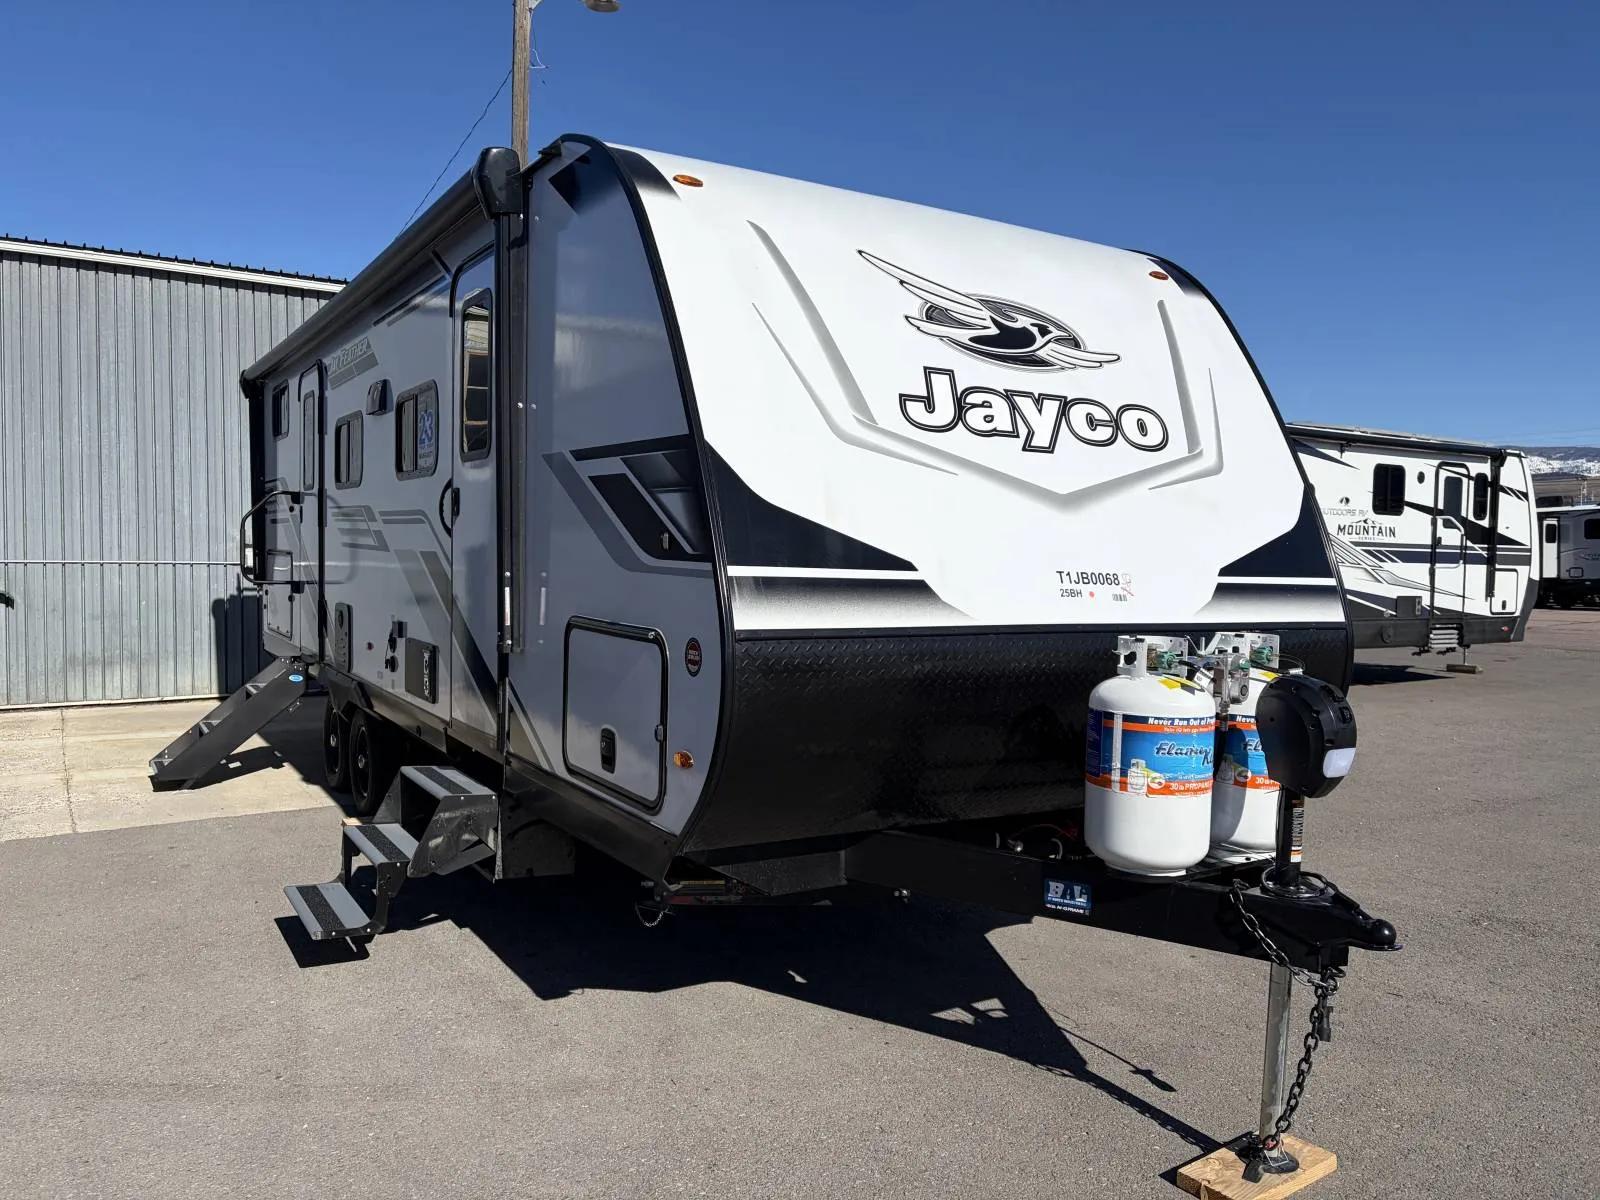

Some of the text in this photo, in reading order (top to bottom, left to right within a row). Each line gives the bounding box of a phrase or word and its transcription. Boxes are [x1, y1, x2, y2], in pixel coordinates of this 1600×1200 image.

[899, 366, 1169, 454] Jayco
[1322, 508, 1358, 517] UTDOORS
[1337, 524, 1396, 538] MOUNTAIN
[1056, 571, 1120, 586] T1JB0068
[1060, 588, 1083, 599] 25BH
[1148, 717, 1172, 726] Never
[1174, 718, 1189, 726] Run
[1236, 715, 1255, 724] Neve
